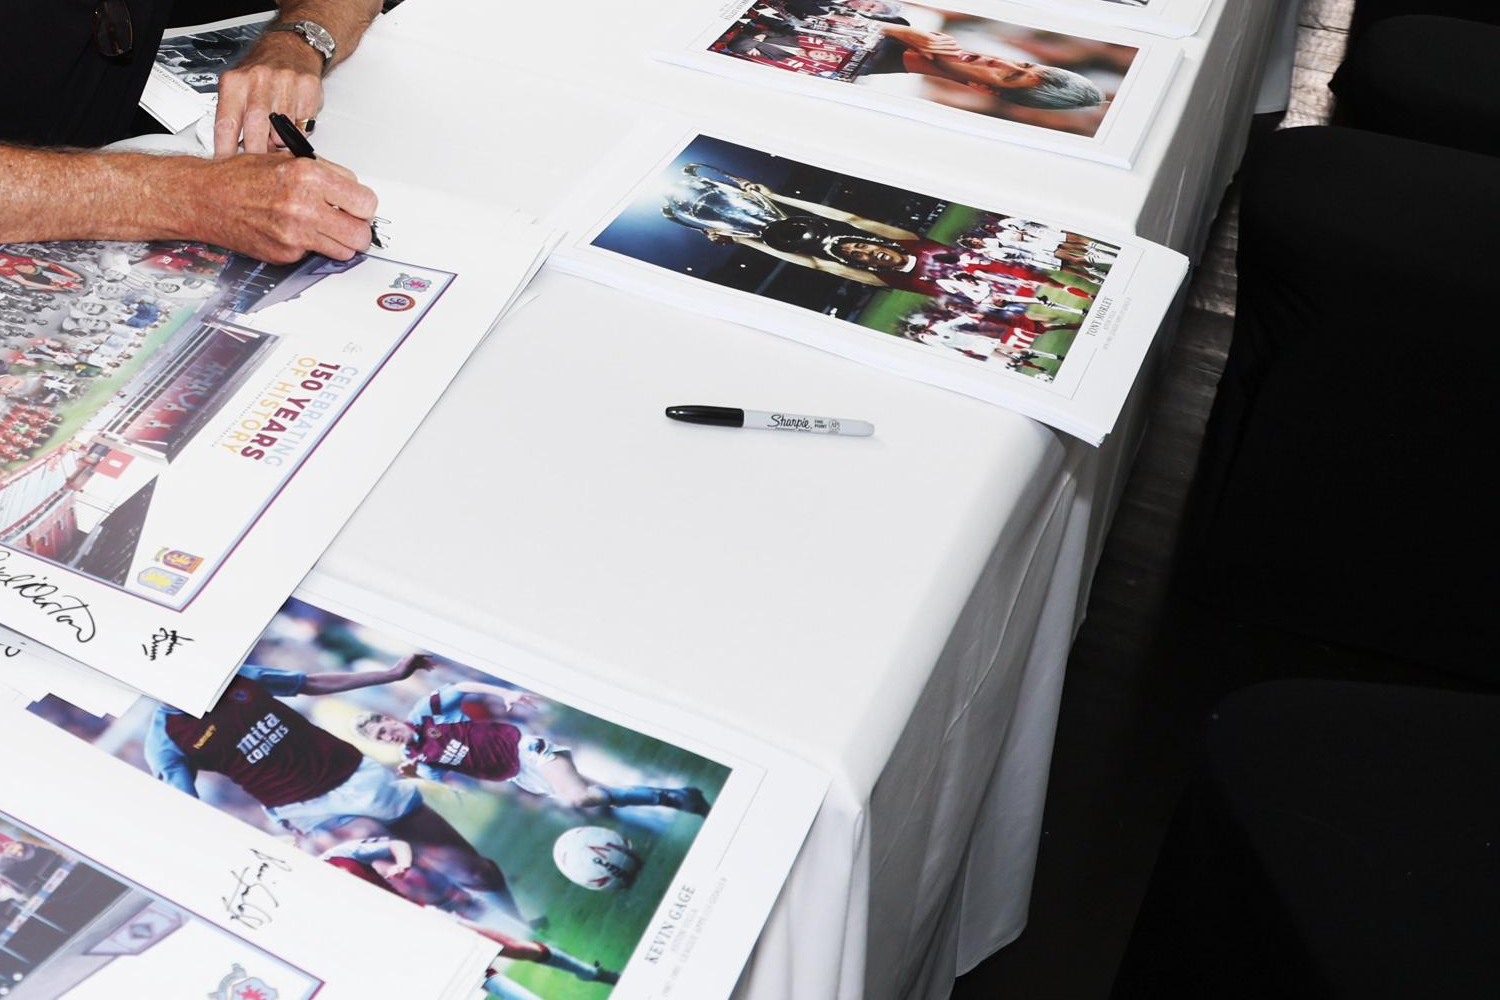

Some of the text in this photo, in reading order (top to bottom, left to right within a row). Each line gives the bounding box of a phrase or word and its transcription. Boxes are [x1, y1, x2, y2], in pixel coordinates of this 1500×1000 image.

[291, 357, 317, 377] OF
[300, 362, 341, 391] 150
[221, 381, 295, 453] HISTORY
[241, 397, 312, 460] YEARS
[265, 366, 359, 467] CELEBRATING
[767, 414, 810, 430] Sharpie
[236, 712, 281, 754] mita
[246, 724, 289, 764] copiers
[645, 923, 675, 964] KEVIN
[668, 884, 695, 921] GAGE
